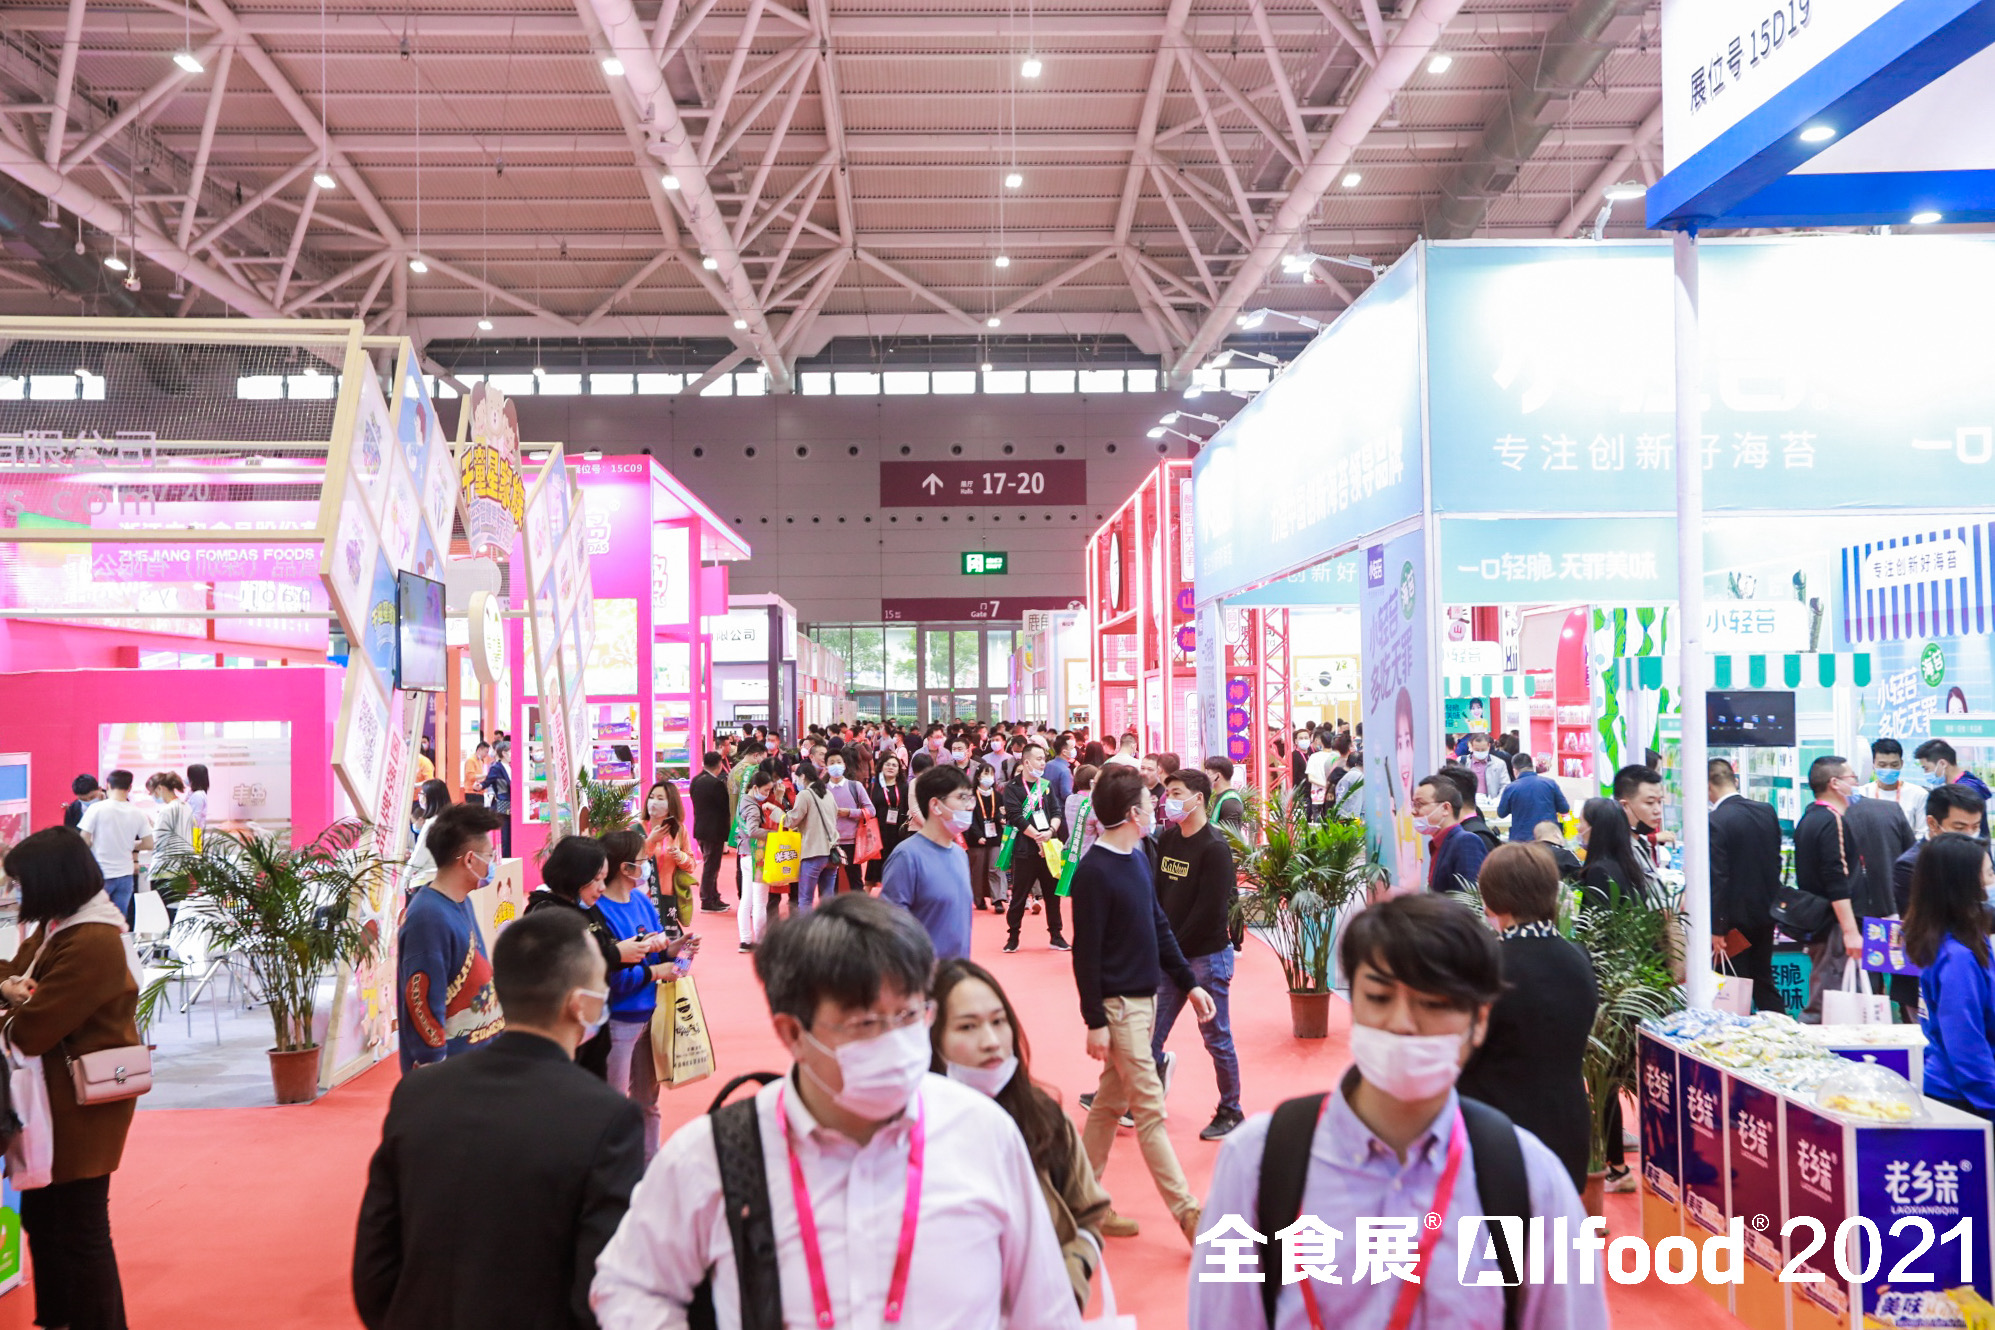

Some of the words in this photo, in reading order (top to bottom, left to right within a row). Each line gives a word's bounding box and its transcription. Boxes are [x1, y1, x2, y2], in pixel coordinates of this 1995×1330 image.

[1690, 35, 1742, 112] 展位号
[1750, 0, 1810, 65] 15D19
[611, 464, 642, 473] 15C09
[983, 472, 1045, 495] 17-20
[118, 549, 191, 562] ZHEJIANG
[196, 549, 258, 561] FOMDAS
[264, 548, 314, 560] FOODS
[970, 610, 988, 619] Gate
[989, 601, 1000, 618] 7
[1369, 587, 1399, 659] 小轻苔
[1706, 608, 1776, 634] 小轻苔
[1370, 625, 1413, 716] 多吃无罪
[1921, 648, 1945, 680] 海苔
[1877, 666, 1919, 711] 小轻苔
[1737, 1109, 1768, 1159] 老乡亲
[1797, 1138, 1833, 1193] 老乡亲
